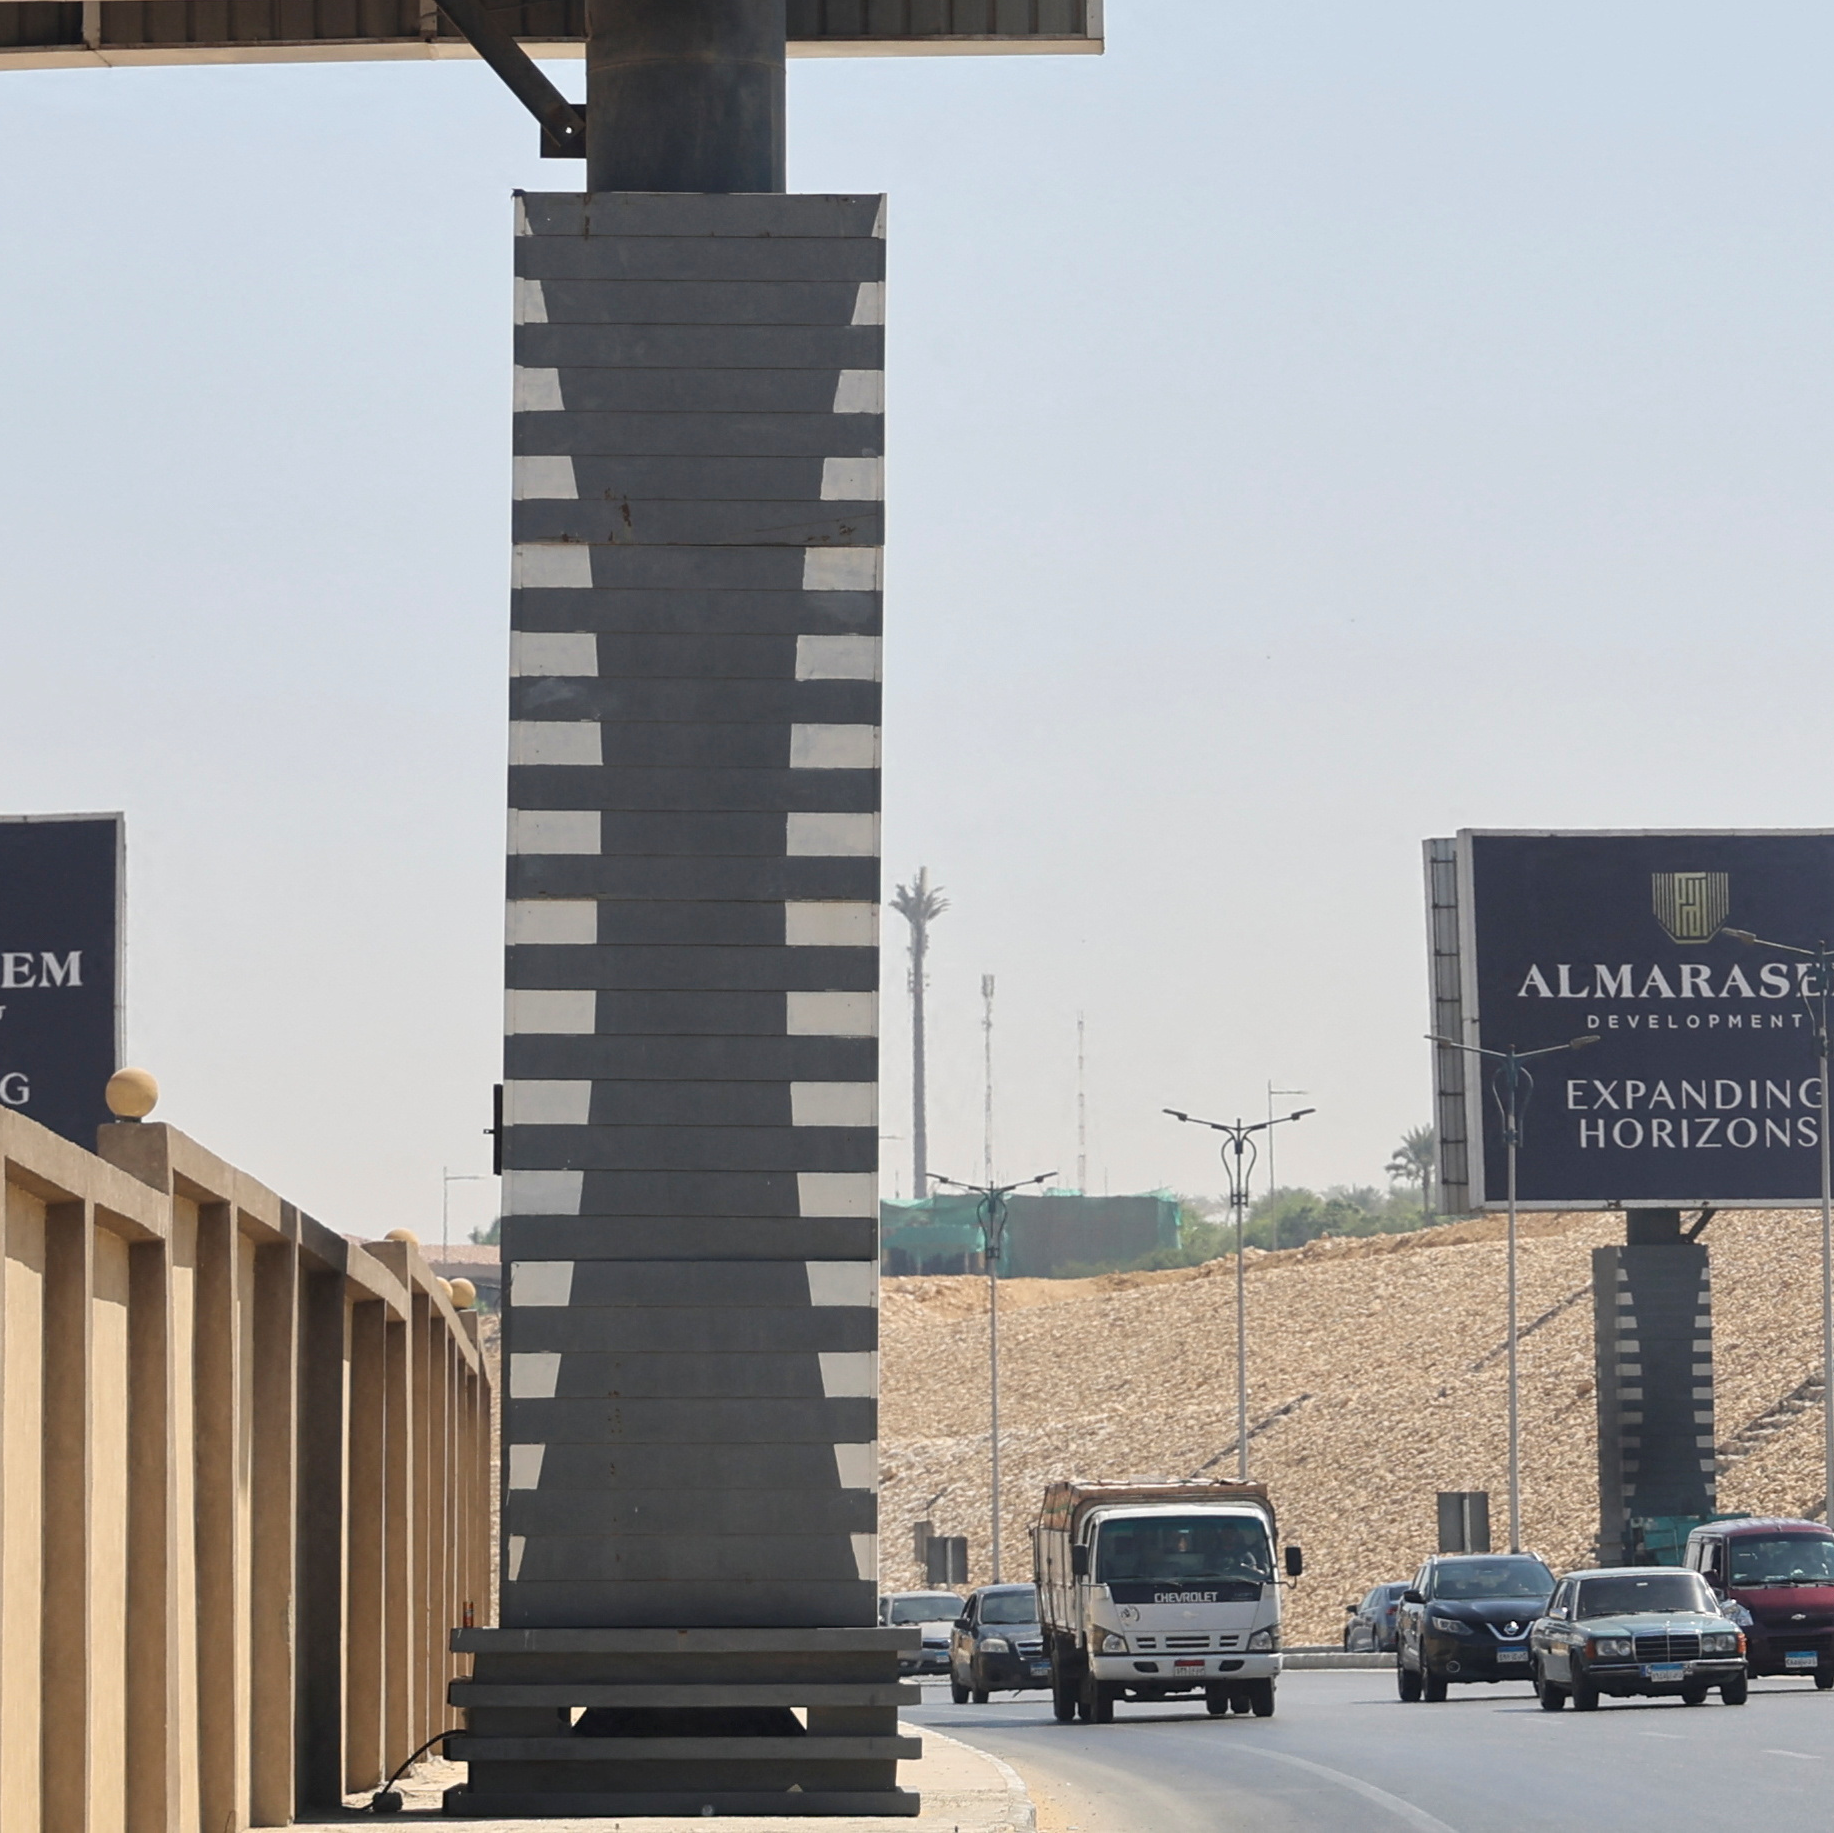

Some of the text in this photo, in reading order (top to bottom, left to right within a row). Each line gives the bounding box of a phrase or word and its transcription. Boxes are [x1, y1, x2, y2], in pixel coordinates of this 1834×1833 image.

[1587, 1012, 1804, 1029] DEVELOPMENT
[1566, 1076, 1823, 1110] EXPANDING
[1579, 1116, 1820, 1150] HORIZONS
[1154, 1591, 1218, 1603] CHEVROLET
